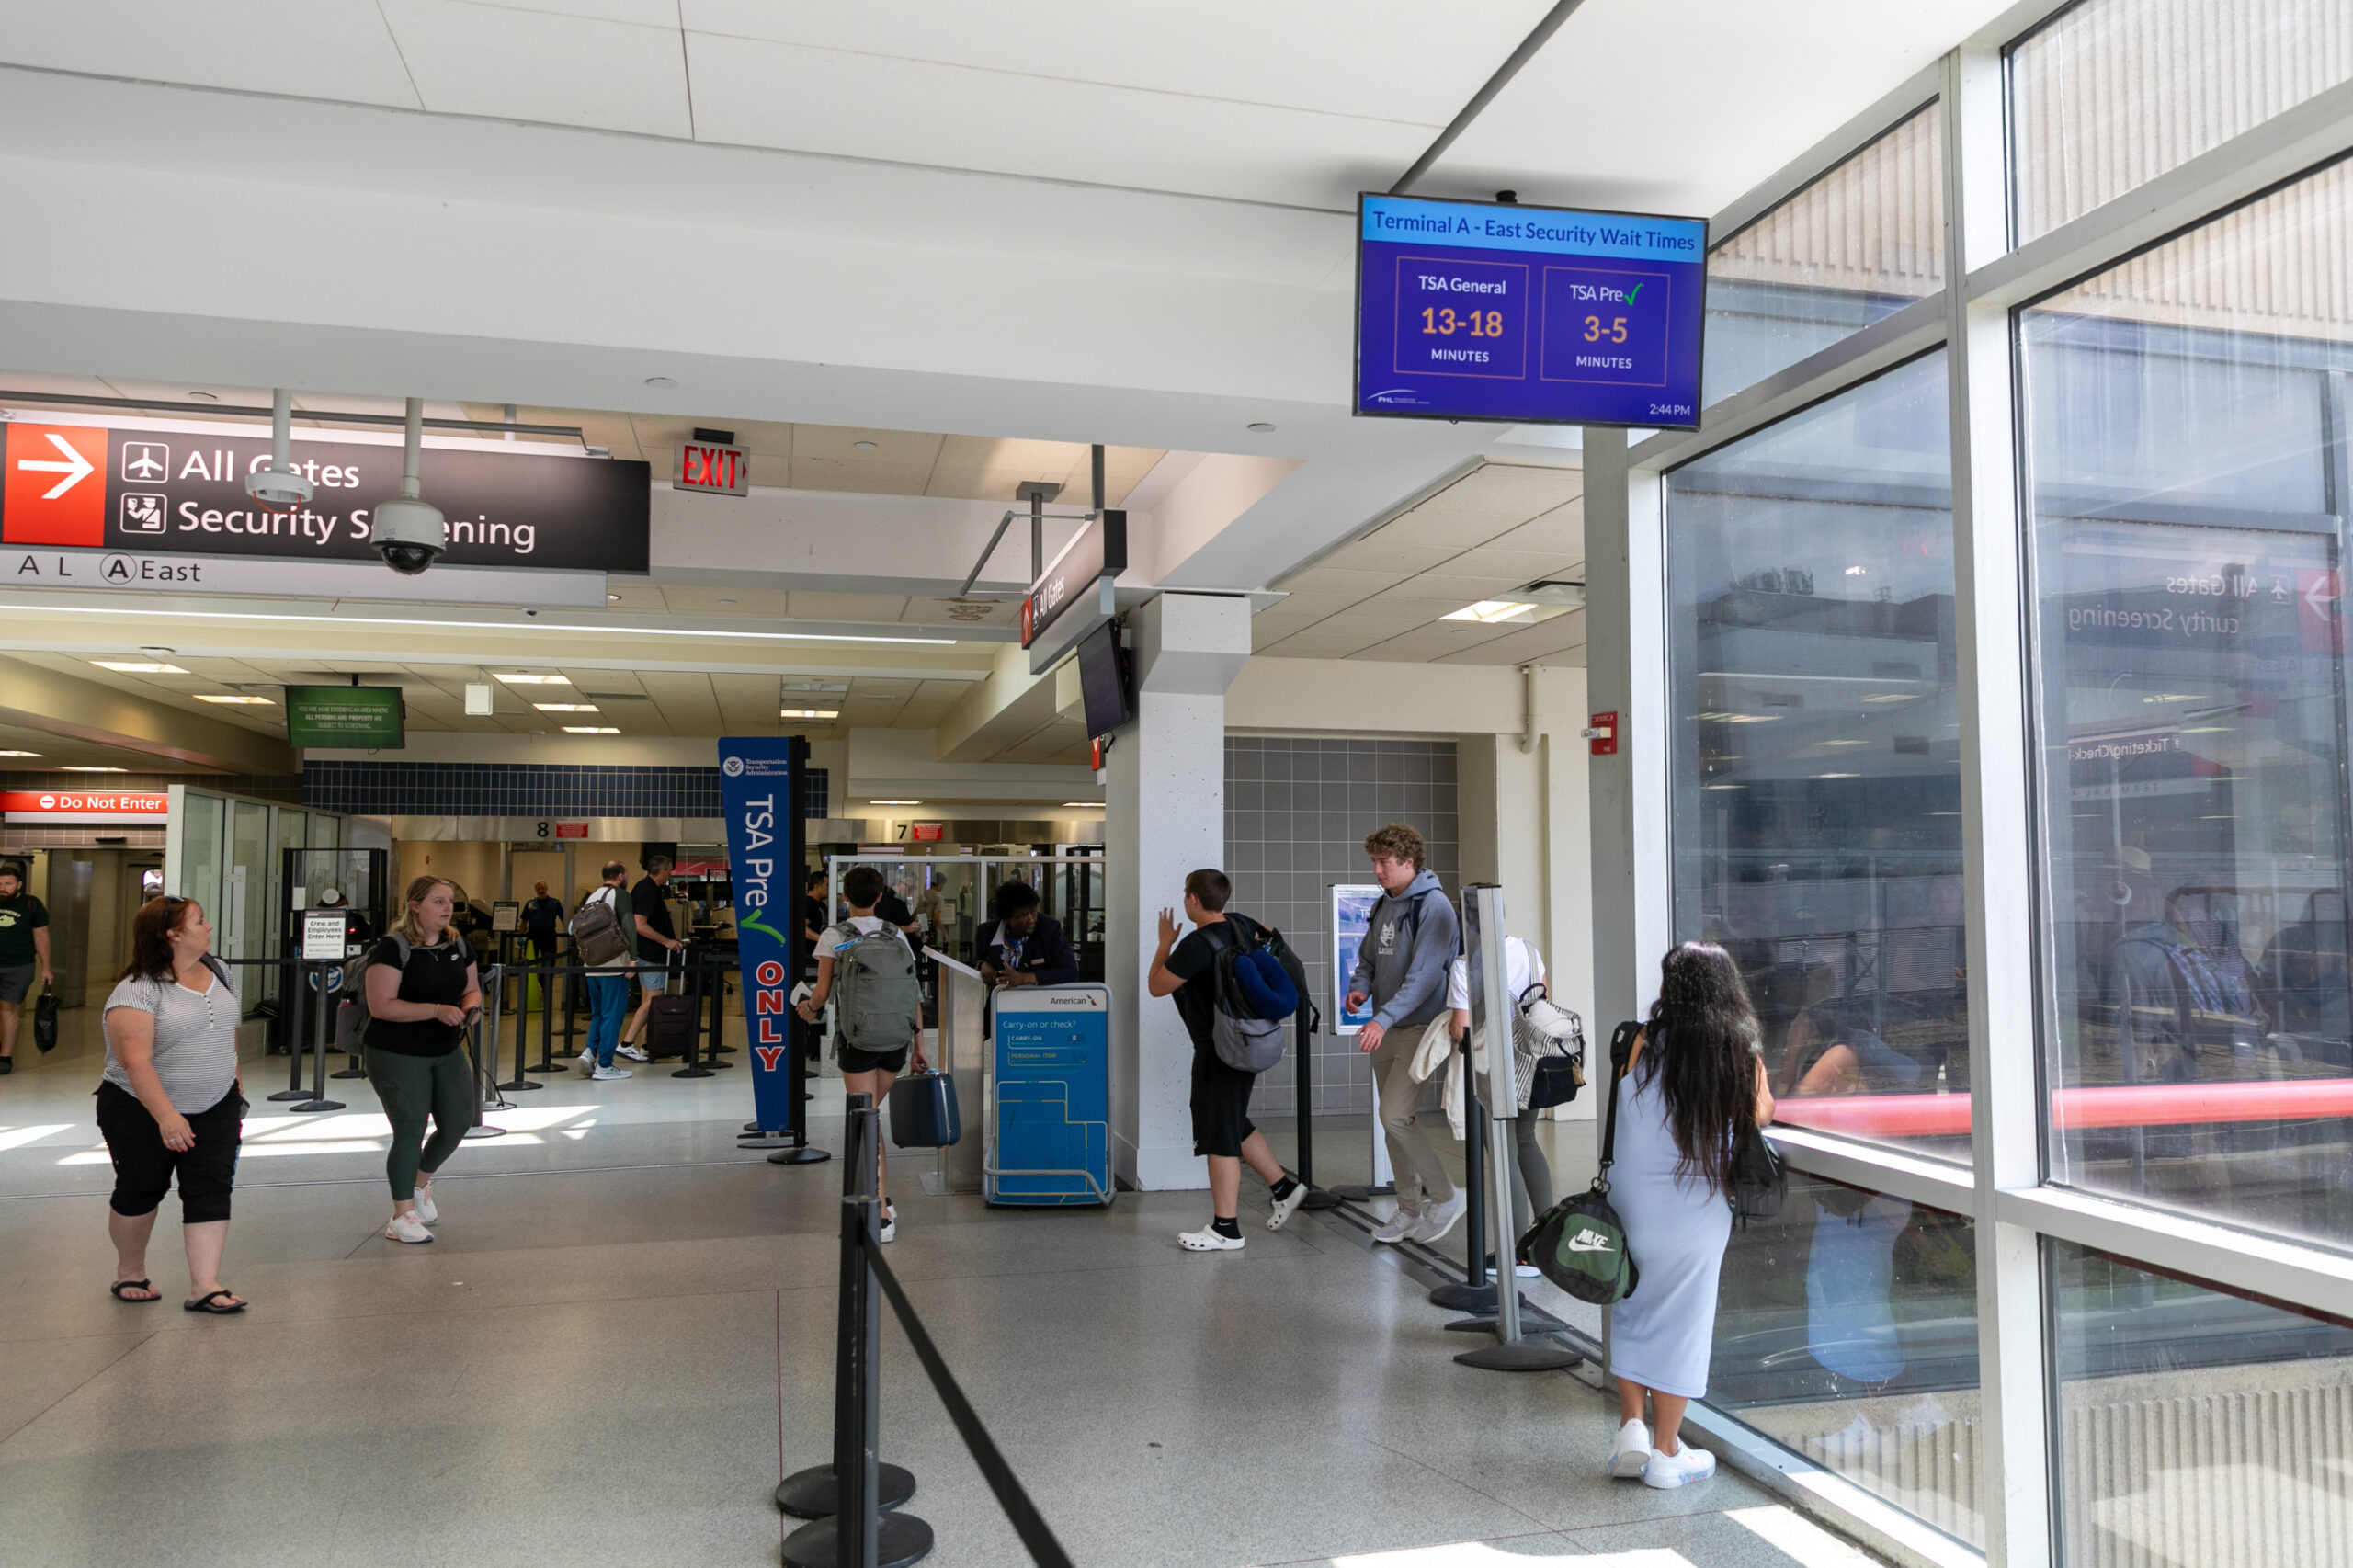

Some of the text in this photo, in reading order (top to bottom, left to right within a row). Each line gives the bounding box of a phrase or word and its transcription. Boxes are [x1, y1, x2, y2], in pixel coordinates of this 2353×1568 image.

[1373, 210, 1452, 233] Terminal
[1456, 217, 1470, 234] A
[1485, 219, 1521, 239] East
[1526, 222, 1597, 246] Security
[1600, 228, 1642, 247] Wait
[1645, 231, 1695, 251] Times
[1418, 275, 1506, 295] TSA General
[1570, 284, 1624, 302] TSA Pre
[1422, 306, 1503, 338] 13-18
[1583, 315, 1628, 344] 3-5
[1431, 348, 1490, 363] MINUTES
[1575, 355, 1632, 369] MINUTES
[1649, 403, 1691, 416] 2:44 PM
[179, 449, 234, 482] All
[683, 445, 742, 489] EXIT
[178, 501, 536, 554] Security Sning
[18, 555, 201, 583] A L A East
[1039, 576, 1064, 619] All Gates
[60, 796, 163, 810] Do Not Enter
[537, 822, 549, 837] 8
[897, 824, 907, 839] 7
[745, 793, 774, 907] TSA Pre
[756, 960, 786, 1072] ONLY
[1003, 1020, 1038, 1030] Carry-on
[1050, 1020, 1076, 1028] check?
[1576, 1228, 1608, 1249] NIKE
